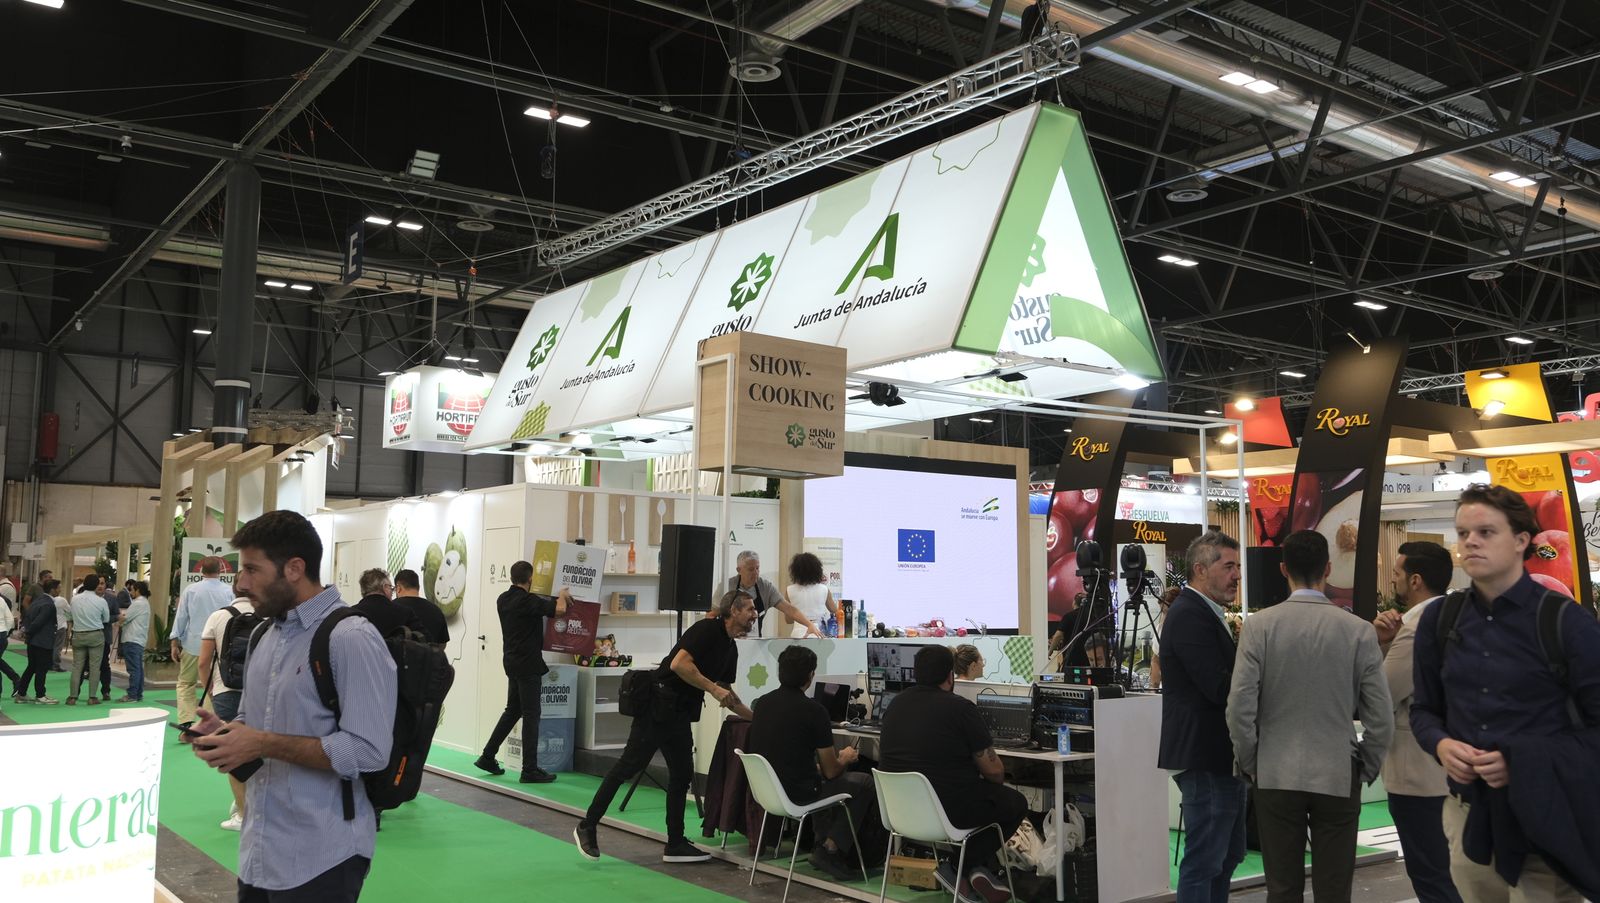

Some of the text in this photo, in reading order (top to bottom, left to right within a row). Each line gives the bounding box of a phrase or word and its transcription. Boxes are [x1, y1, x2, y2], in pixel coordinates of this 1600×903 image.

[348, 231, 359, 275] E
[793, 277, 928, 329] Junta de Andalucía
[559, 359, 636, 390] Junta de Andalucía
[749, 353, 811, 378] SHOW-
[508, 373, 539, 399] gusto
[511, 390, 532, 408] Sur
[748, 382, 835, 412] COOKING
[808, 428, 836, 441] gusto
[817, 437, 836, 450] Sur
[1396, 482, 1411, 494] 1998
[1132, 520, 1167, 545] ROYAL
[562, 564, 597, 578] FUNDACIÓN
[570, 575, 593, 586] OLIVAR
[545, 694, 568, 704] OLIVAR
